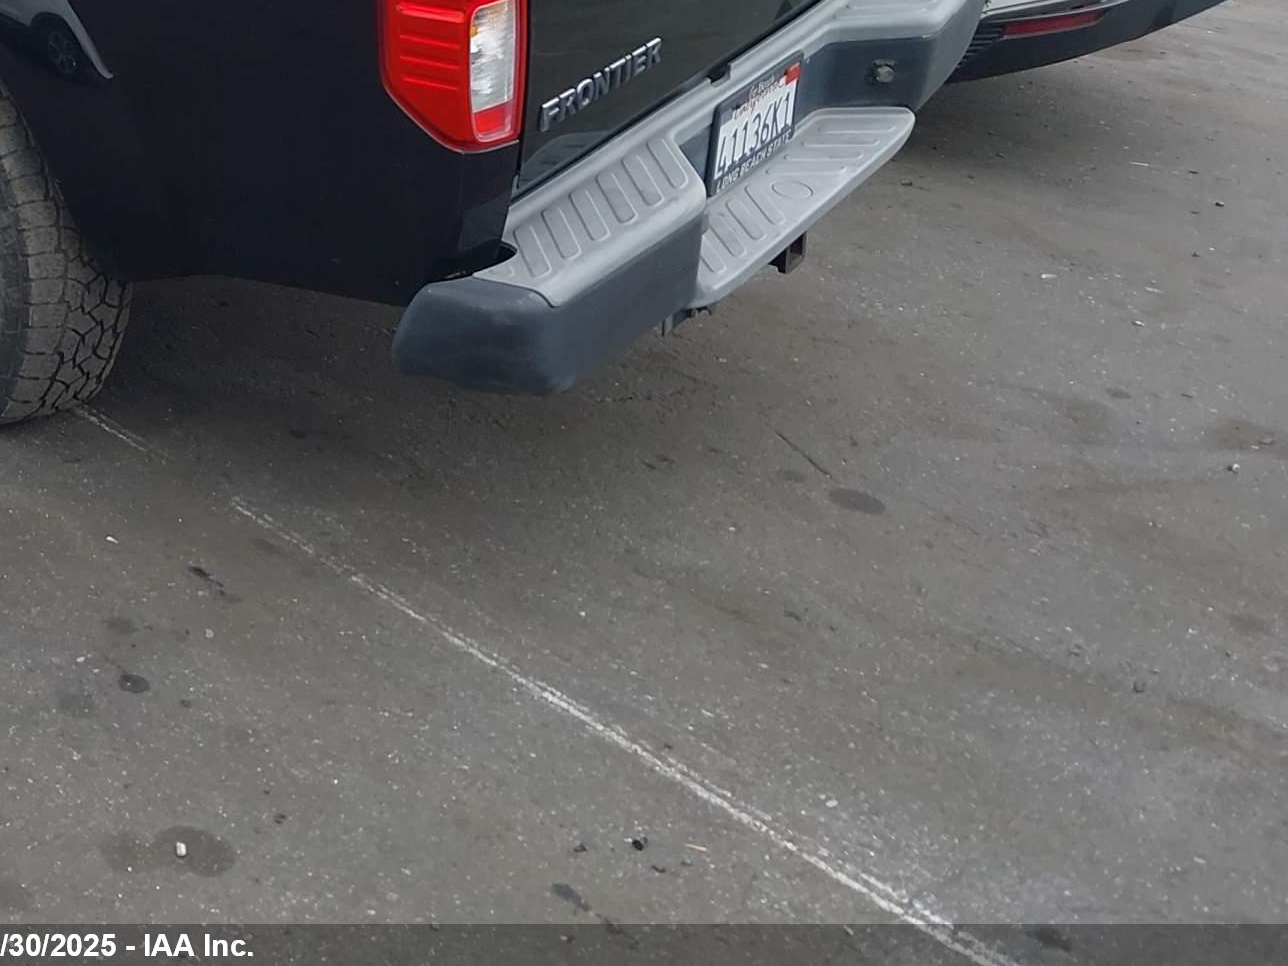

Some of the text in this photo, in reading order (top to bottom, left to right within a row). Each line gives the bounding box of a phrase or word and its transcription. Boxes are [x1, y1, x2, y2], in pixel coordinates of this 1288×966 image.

[538, 36, 662, 132] FRONTIER
[716, 130, 793, 194] LONG BEACH STATE
[717, 91, 793, 175] 41136K1
